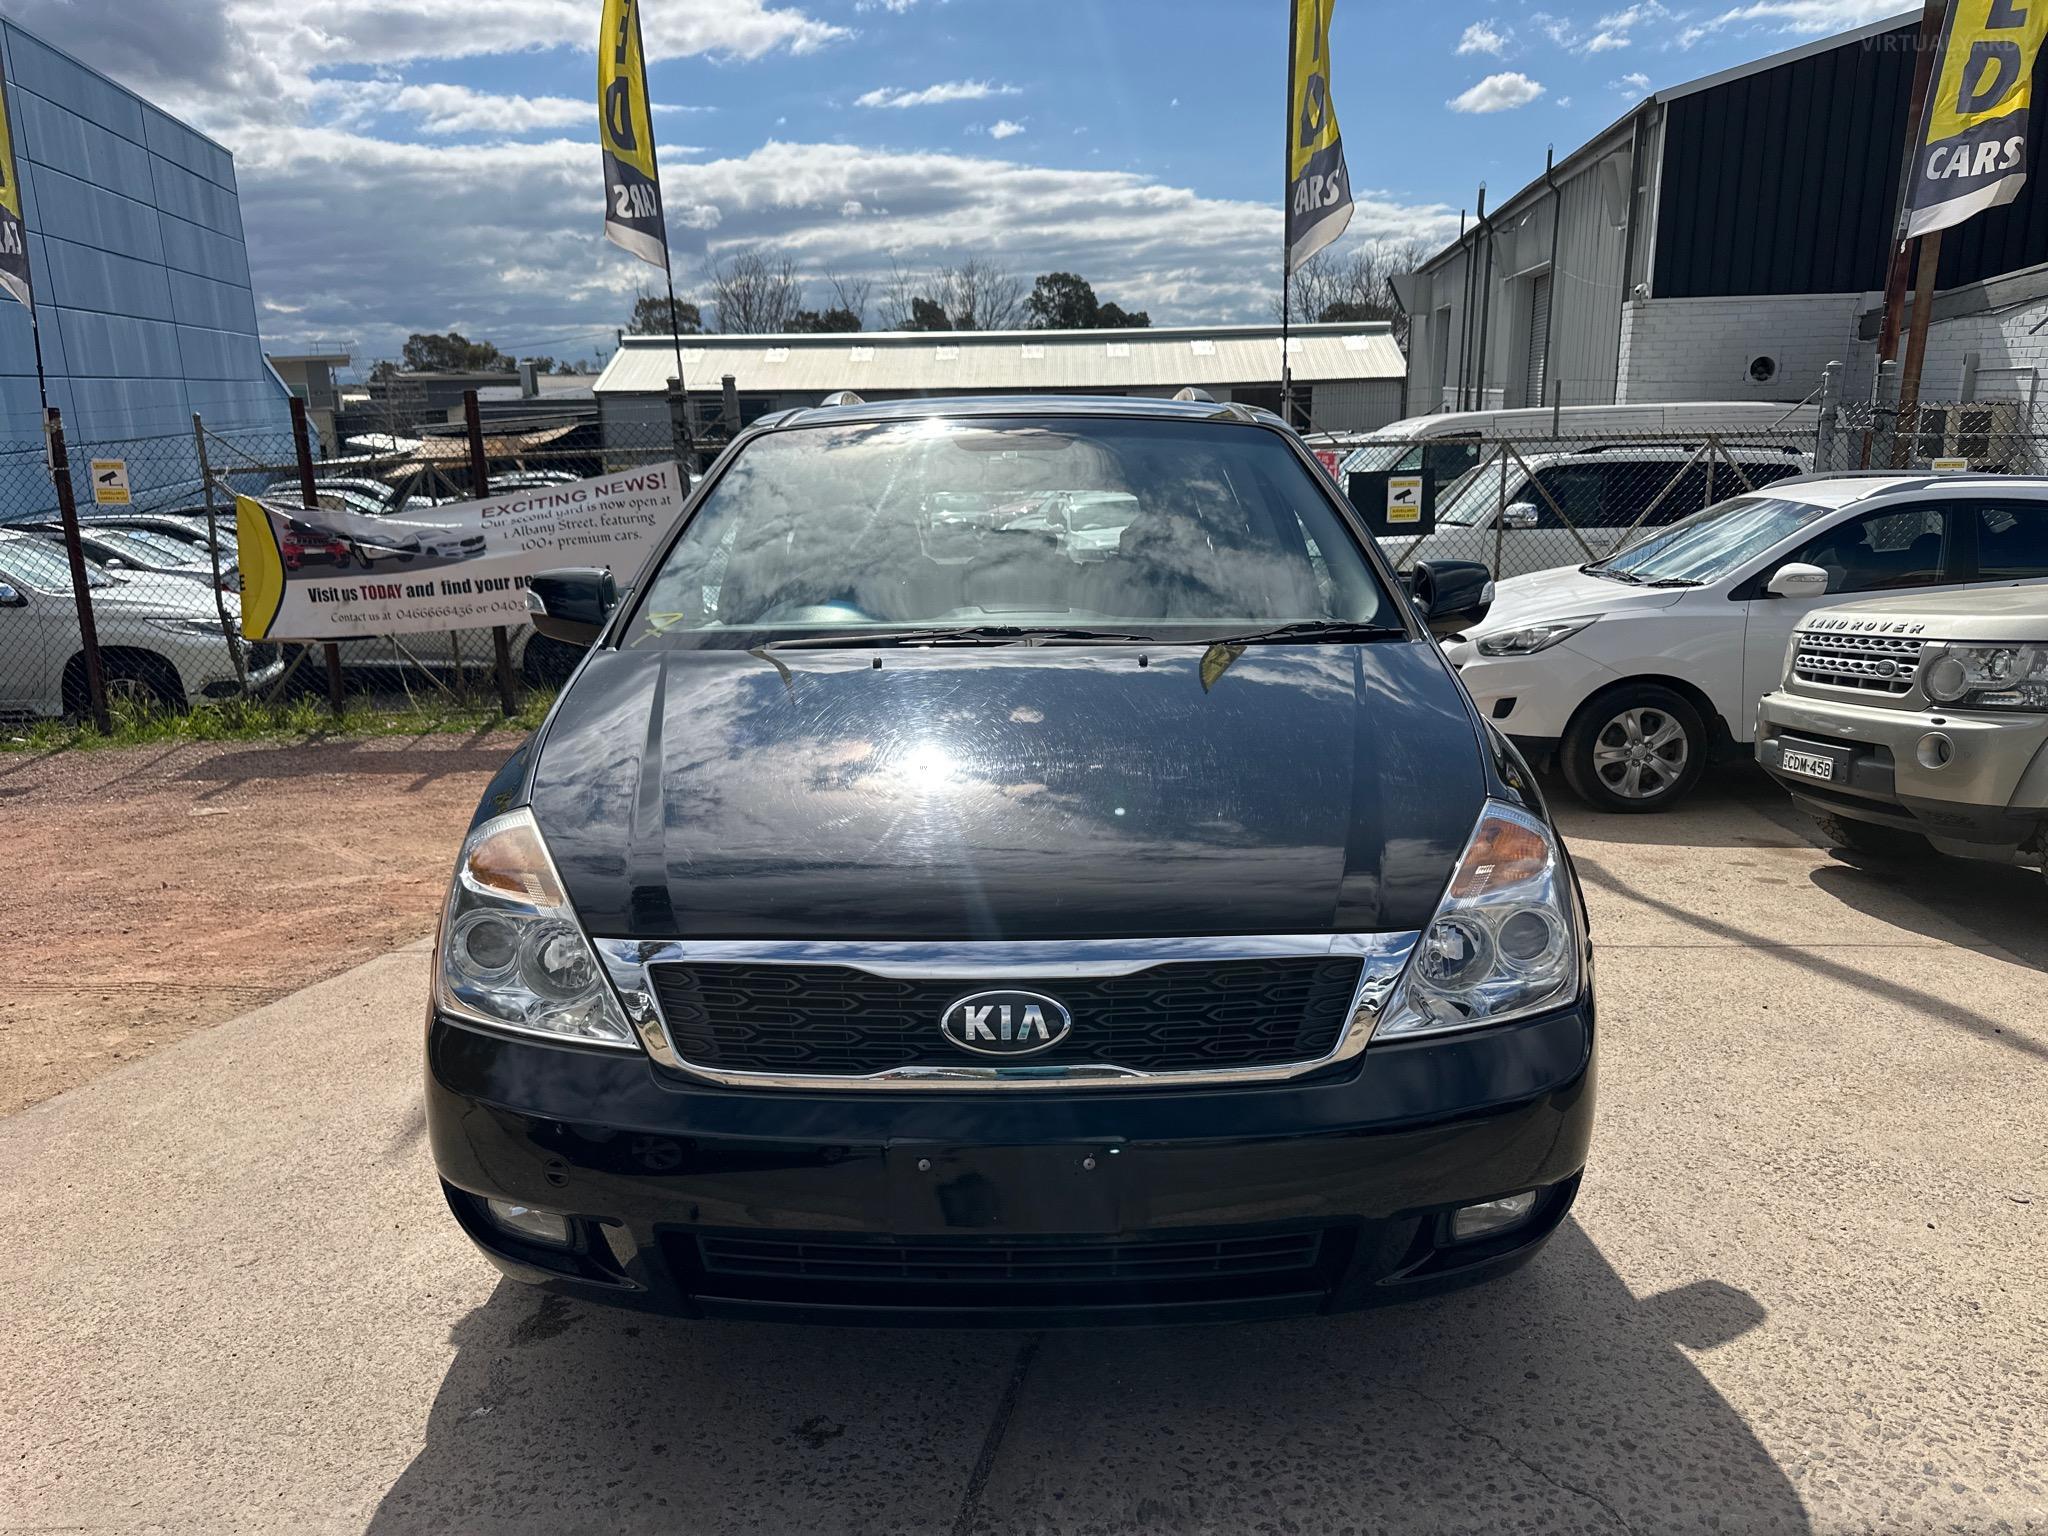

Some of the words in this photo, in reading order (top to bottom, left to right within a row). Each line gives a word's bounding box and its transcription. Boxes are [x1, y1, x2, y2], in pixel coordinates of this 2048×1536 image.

[1926, 135, 2025, 180] CARS
[481, 490, 587, 518] EXCITING
[595, 472, 667, 498] NEWS!
[481, 519, 505, 529] Our
[511, 510, 552, 524] second
[556, 503, 583, 520] yard
[587, 501, 597, 512] is
[600, 499, 626, 511] now
[629, 496, 658, 511] open
[661, 495, 673, 506] at
[512, 524, 555, 538] Albany
[600, 512, 656, 527] featuring
[521, 537, 553, 551] 100+
[558, 531, 611, 550] premium
[614, 531, 642, 542] cars.
[307, 587, 340, 603] Visit
[341, 588, 358, 601] us
[359, 584, 402, 600] TODAY
[406, 581, 435, 598] and
[441, 578, 472, 595] find
[475, 577, 510, 594] your
[514, 575, 534, 590] pe
[331, 612, 366, 623] Contact
[368, 613, 380, 621] us
[383, 612, 392, 620] at
[476, 604, 489, 614] or
[490, 600, 526, 613] 0403
[963, 1005, 1050, 1040] KIA
